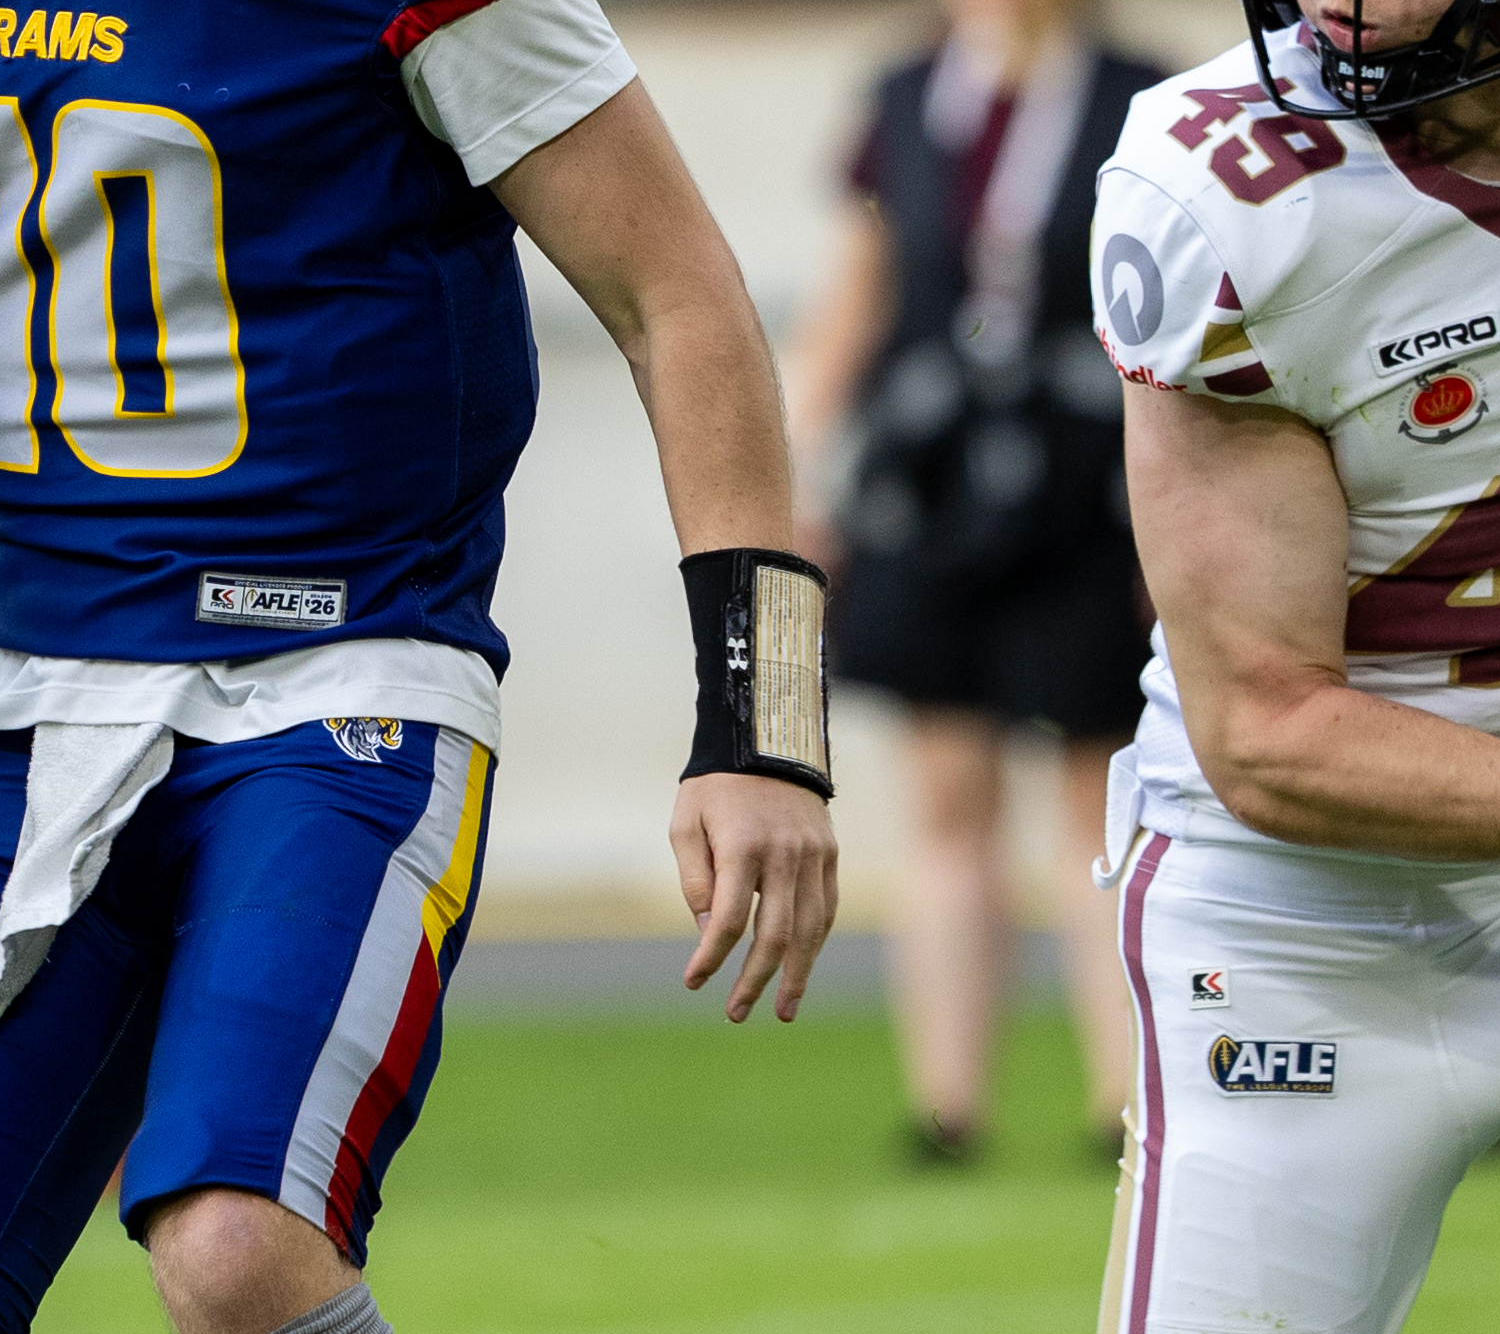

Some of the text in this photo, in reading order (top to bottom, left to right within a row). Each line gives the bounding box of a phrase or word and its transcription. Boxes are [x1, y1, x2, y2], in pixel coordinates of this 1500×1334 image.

[1165, 76, 1347, 208] 49
[250, 592, 301, 611] AFLE
[1192, 992, 1224, 1002] PRO
[1226, 1042, 1336, 1083] AFLE
